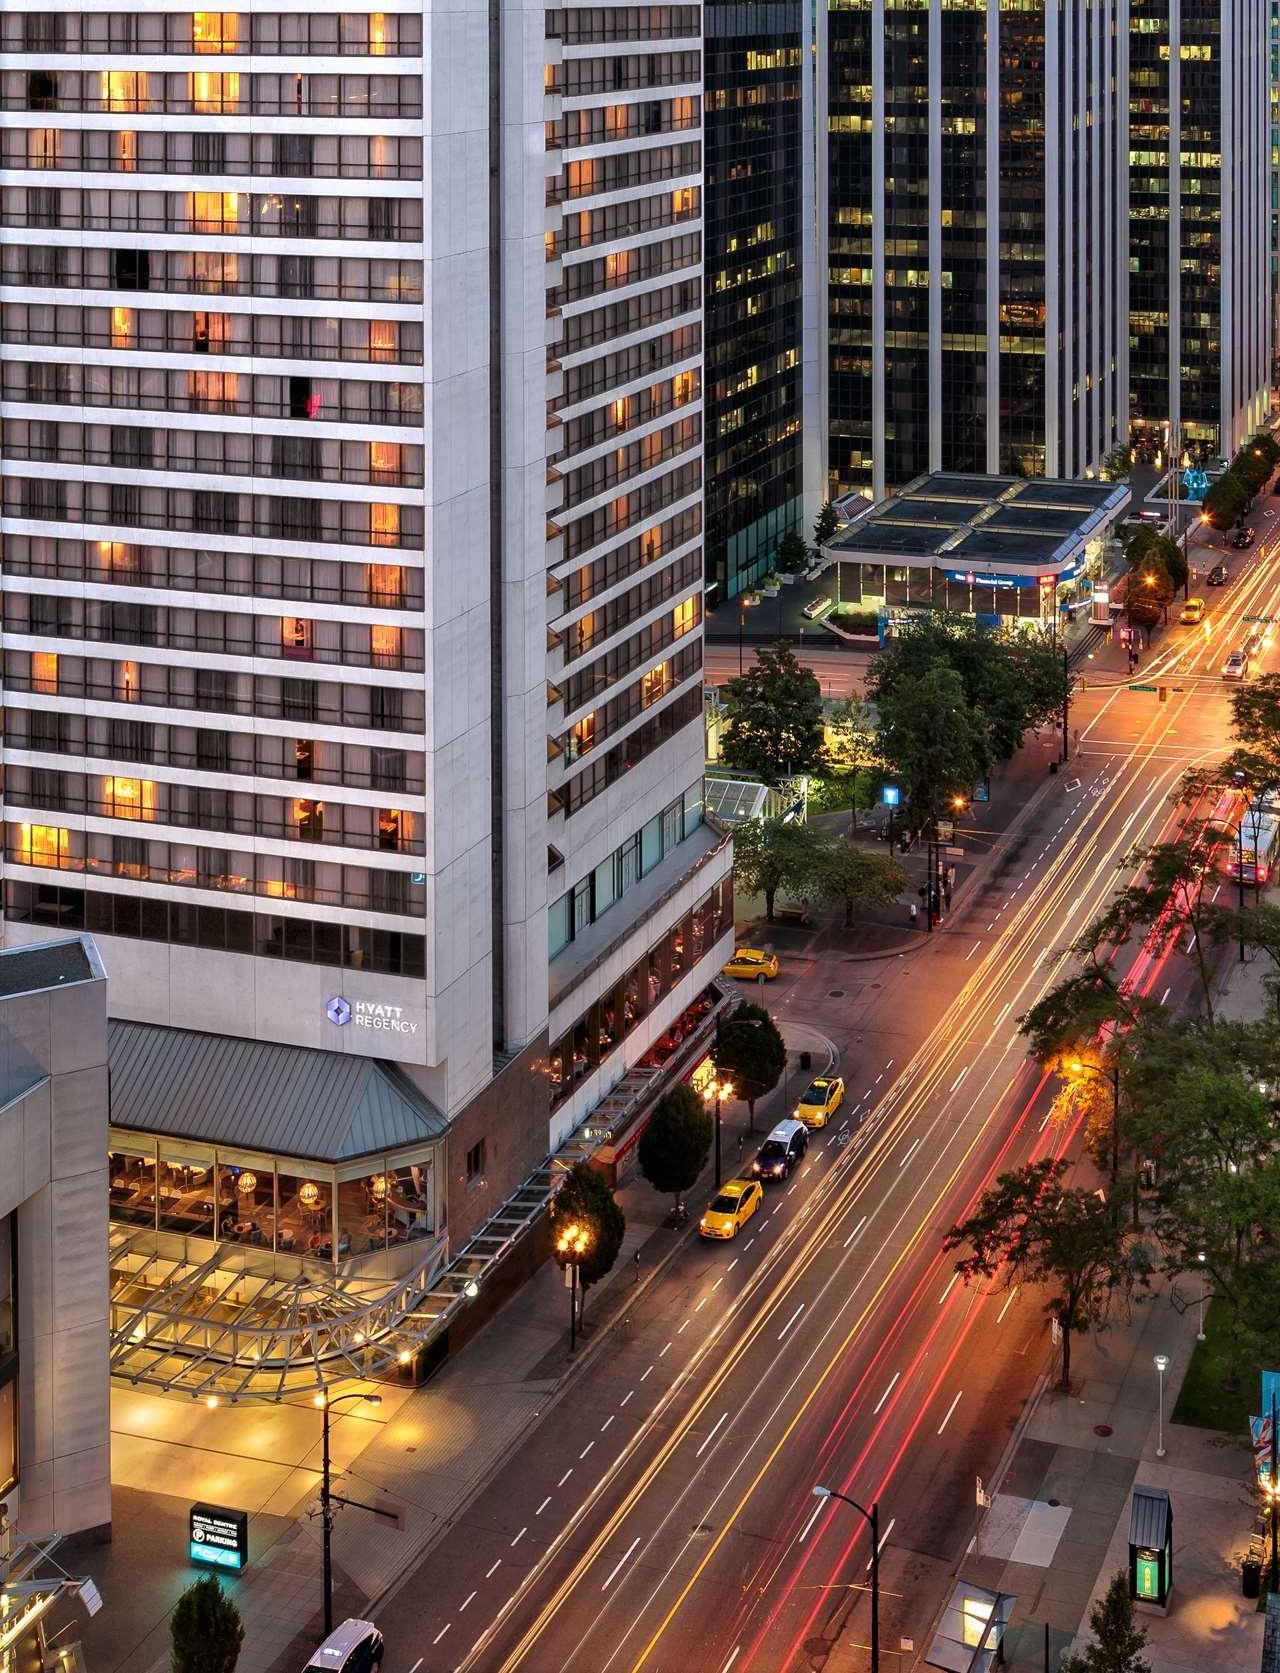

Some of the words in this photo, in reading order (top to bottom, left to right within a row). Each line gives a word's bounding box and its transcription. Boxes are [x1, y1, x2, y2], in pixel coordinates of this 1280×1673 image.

[356, 1001, 403, 1018] HYATT
[356, 1015, 418, 1034] REGENCY
[206, 1533, 238, 1547] PARKING
